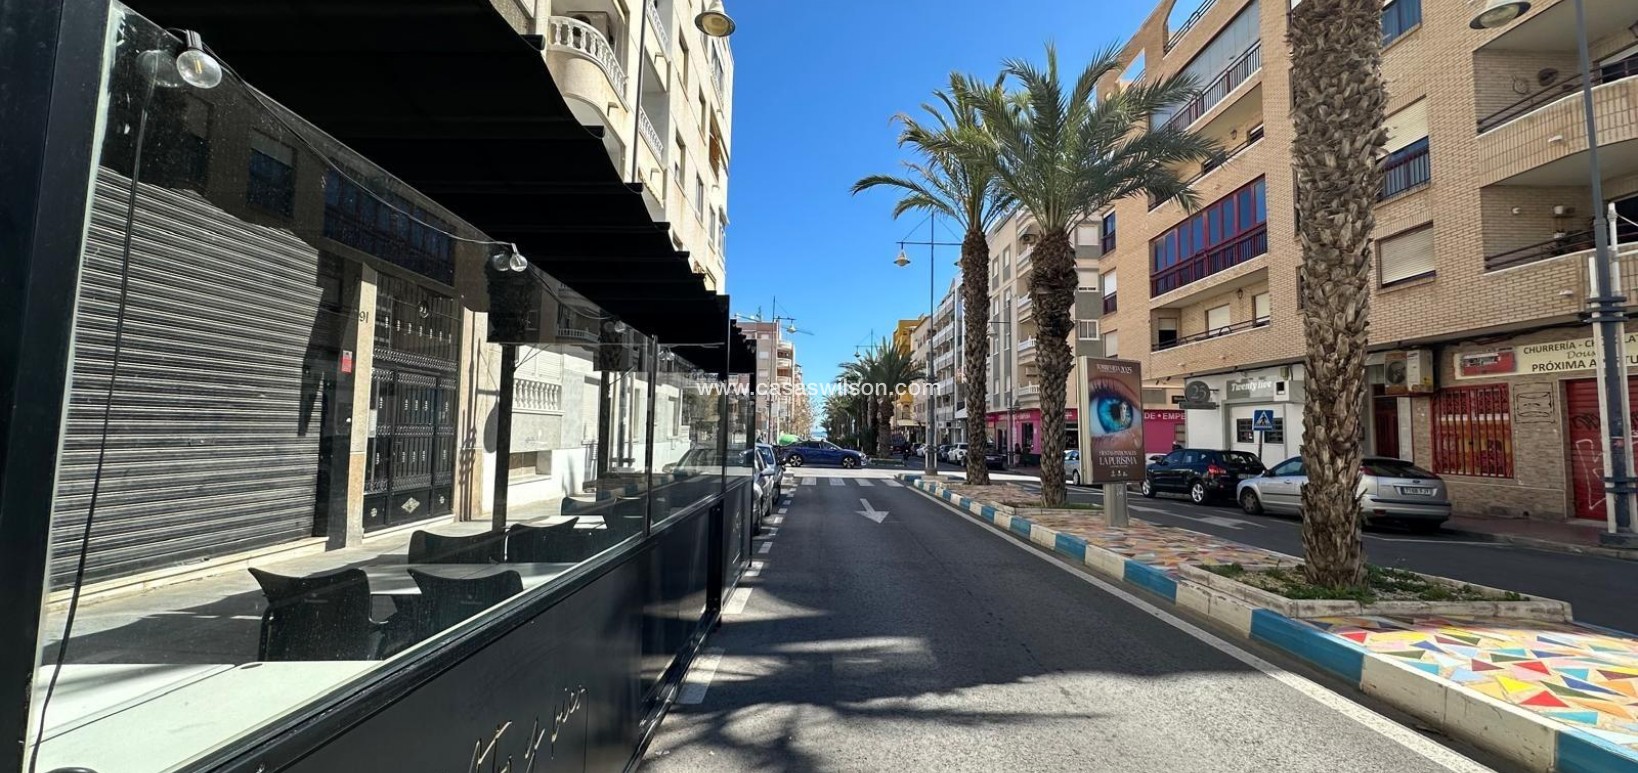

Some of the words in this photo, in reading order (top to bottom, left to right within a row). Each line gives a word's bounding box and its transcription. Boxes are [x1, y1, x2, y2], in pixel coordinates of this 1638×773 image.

[359, 311, 369, 323] 91
[1523, 341, 1576, 354] CHURRERÍA
[1532, 360, 1586, 372] PRÓXIMA
[1190, 385, 1207, 399] 25
[1231, 381, 1257, 392] Twenty
